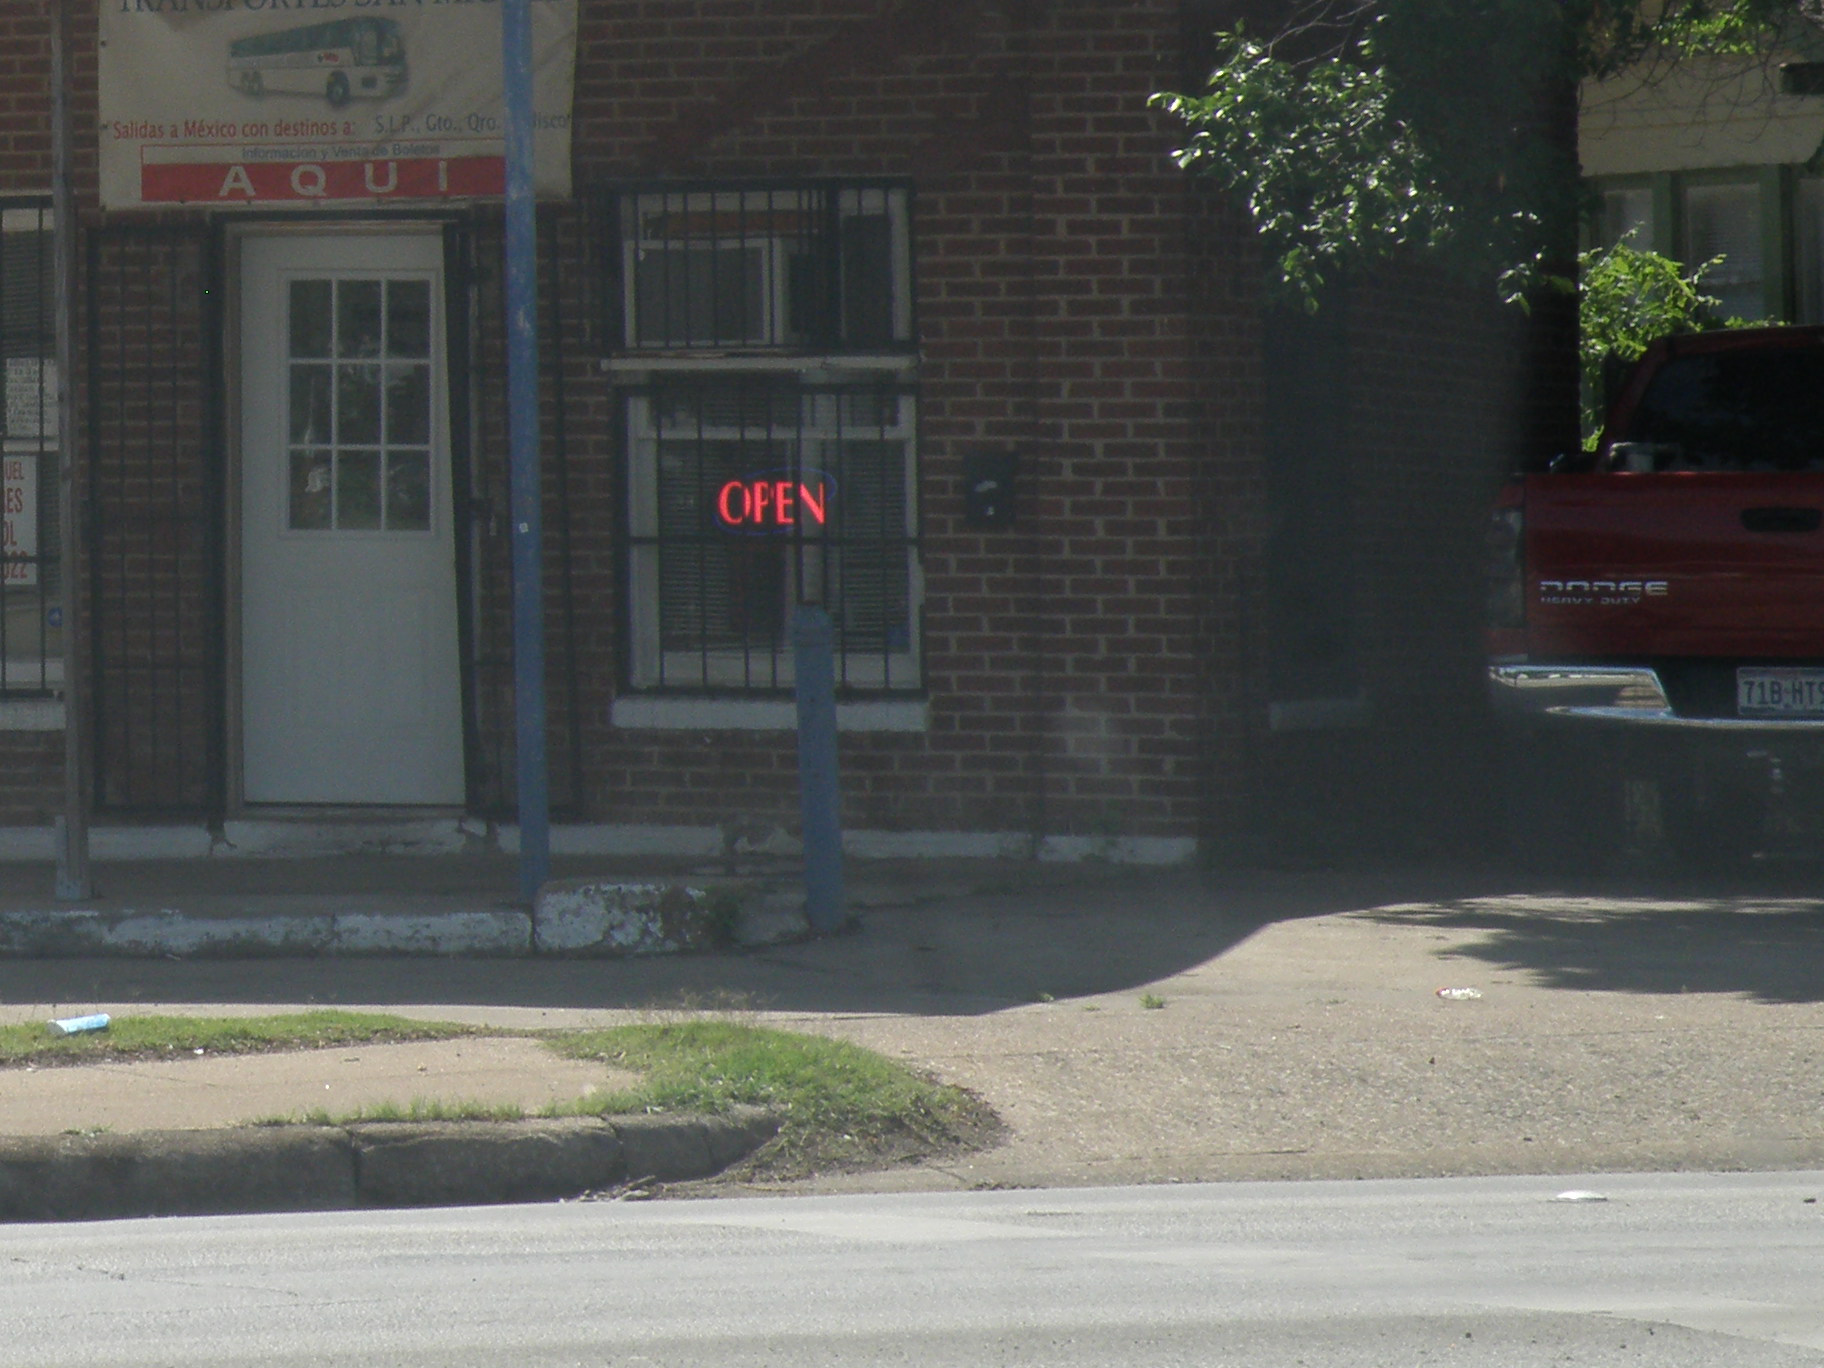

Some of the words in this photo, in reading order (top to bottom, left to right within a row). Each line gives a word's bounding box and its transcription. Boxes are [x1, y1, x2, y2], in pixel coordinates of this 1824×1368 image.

[113, 119, 165, 140] Salidas
[170, 124, 179, 139] a
[184, 119, 237, 139] México
[242, 123, 270, 138] con
[274, 118, 339, 138] destinos
[717, 479, 825, 525] OPEN
